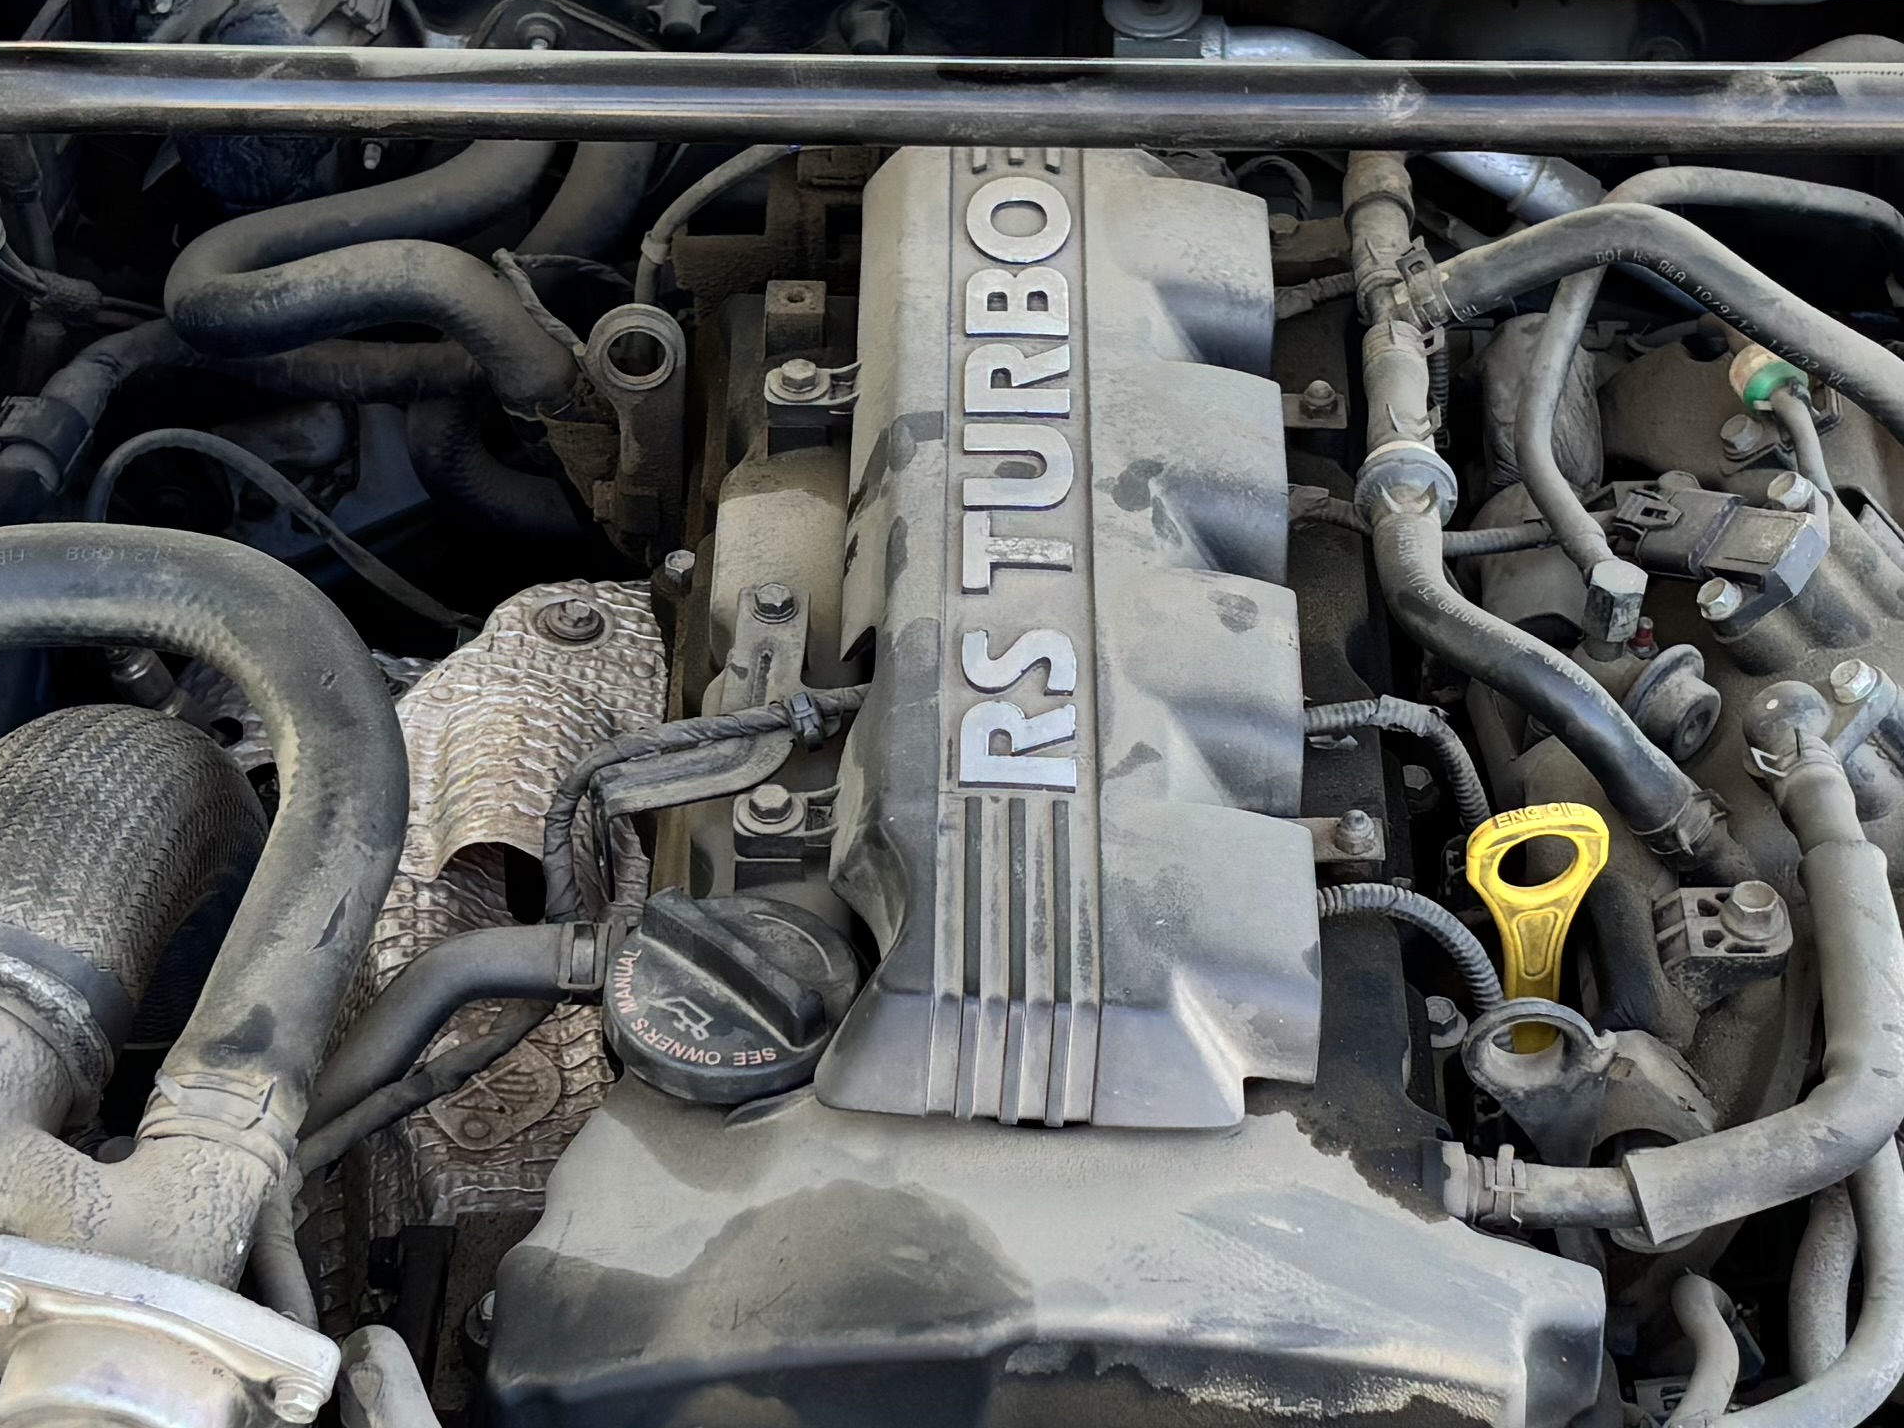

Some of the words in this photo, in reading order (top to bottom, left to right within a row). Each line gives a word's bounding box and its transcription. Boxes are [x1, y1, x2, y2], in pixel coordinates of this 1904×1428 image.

[961, 176, 1075, 595] TURBO
[958, 628, 1077, 791] RS
[1495, 807, 1543, 830] ENG
[1546, 802, 1585, 819] OIL
[610, 948, 643, 1014] MANUAL
[631, 1017, 722, 1066] OWNER'S
[732, 1048, 777, 1067] SEE
